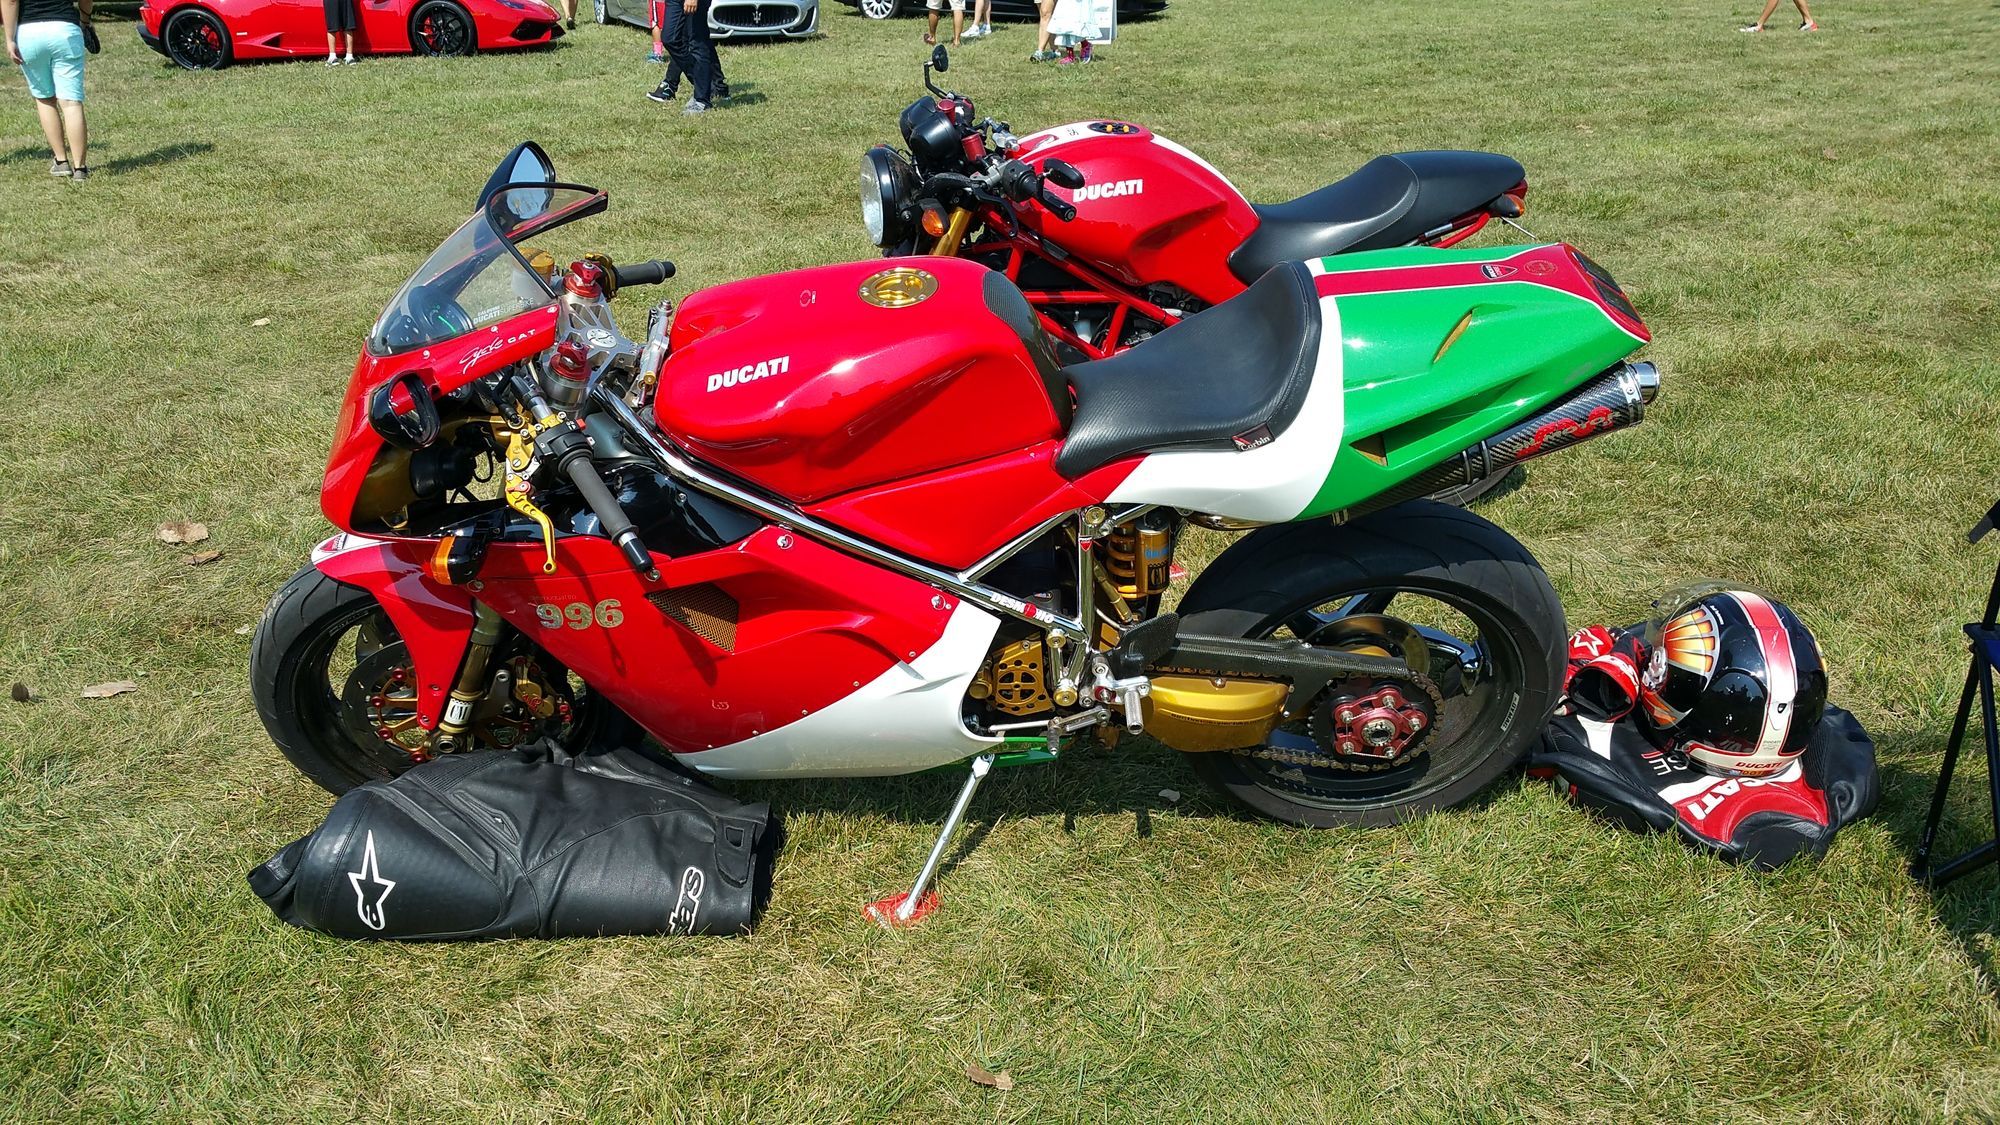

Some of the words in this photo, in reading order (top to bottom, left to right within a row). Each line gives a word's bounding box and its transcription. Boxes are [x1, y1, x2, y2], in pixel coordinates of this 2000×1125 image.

[1073, 179, 1144, 203] DUCATI
[507, 329, 536, 344] CAT
[707, 356, 790, 392] DUCATI
[1241, 436, 1271, 451] Corbin
[536, 598, 624, 630] 996
